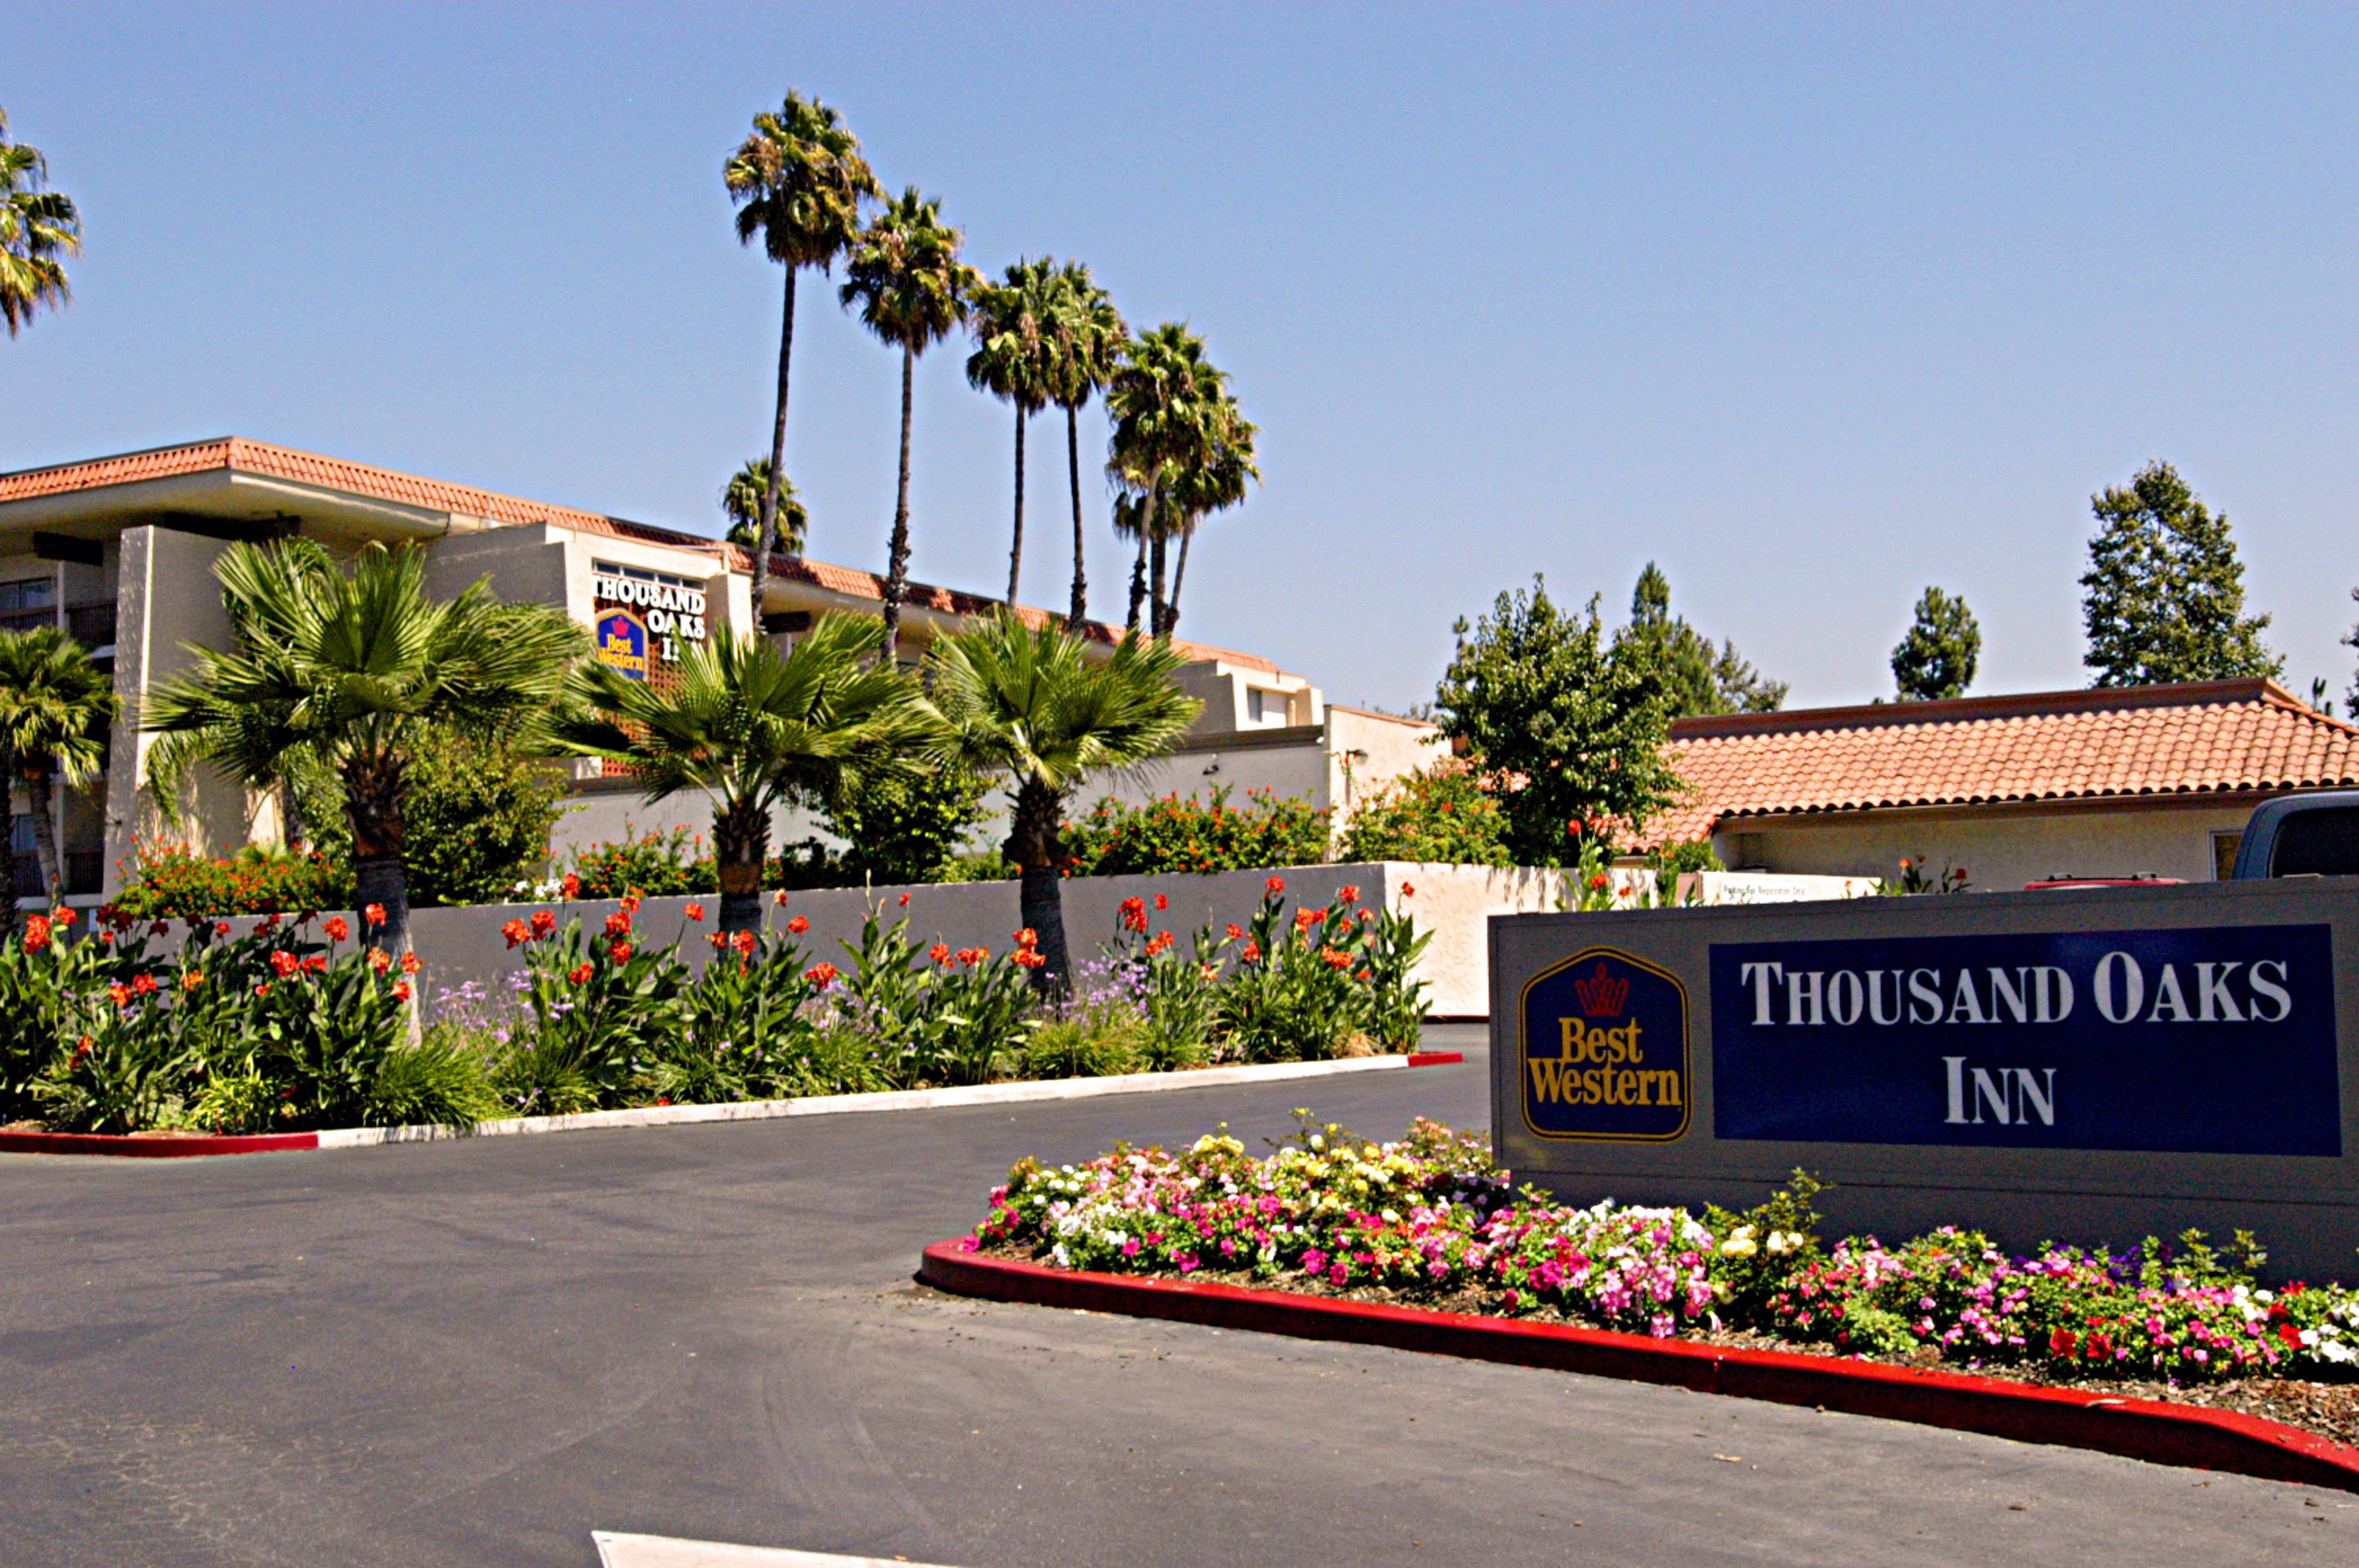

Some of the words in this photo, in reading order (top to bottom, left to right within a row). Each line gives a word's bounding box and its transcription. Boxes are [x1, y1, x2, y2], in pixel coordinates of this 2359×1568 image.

[592, 576, 706, 615] THOUSAND
[607, 634, 632, 654] Best
[648, 609, 706, 639] OAKS
[599, 648, 644, 670] Western
[1741, 962, 2074, 1026] THOUSAND
[2094, 951, 2292, 1024] OAKS
[1559, 1017, 1644, 1063] Best
[1527, 1058, 1682, 1106] Western
[1942, 1056, 2058, 1126] INN
